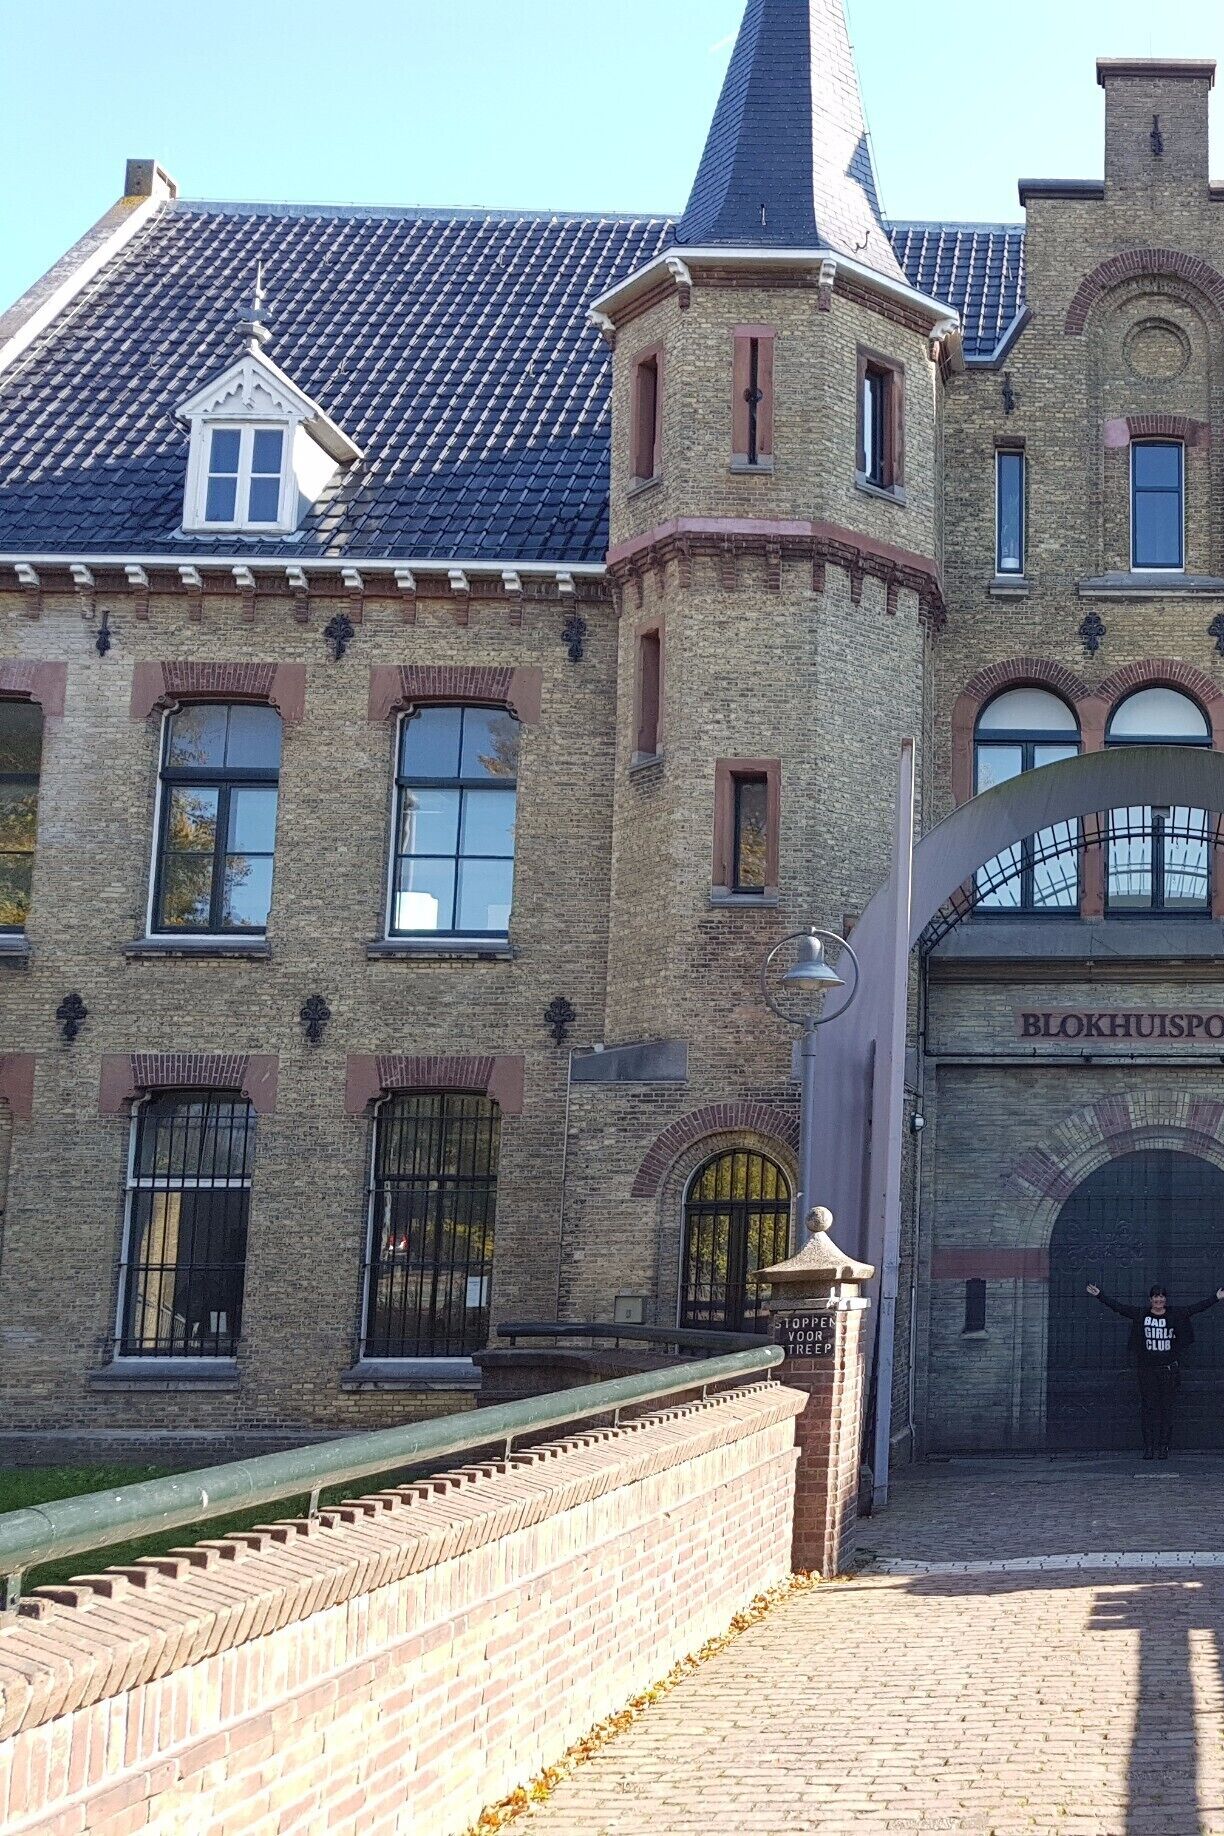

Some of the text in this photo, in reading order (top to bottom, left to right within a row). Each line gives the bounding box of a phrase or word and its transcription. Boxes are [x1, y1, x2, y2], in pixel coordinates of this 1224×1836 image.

[1144, 1316, 1166, 1327] BAD
[788, 1330, 823, 1341] VOOR
[783, 1343, 832, 1355] TREEP
[1145, 1339, 1171, 1351] CLUB
